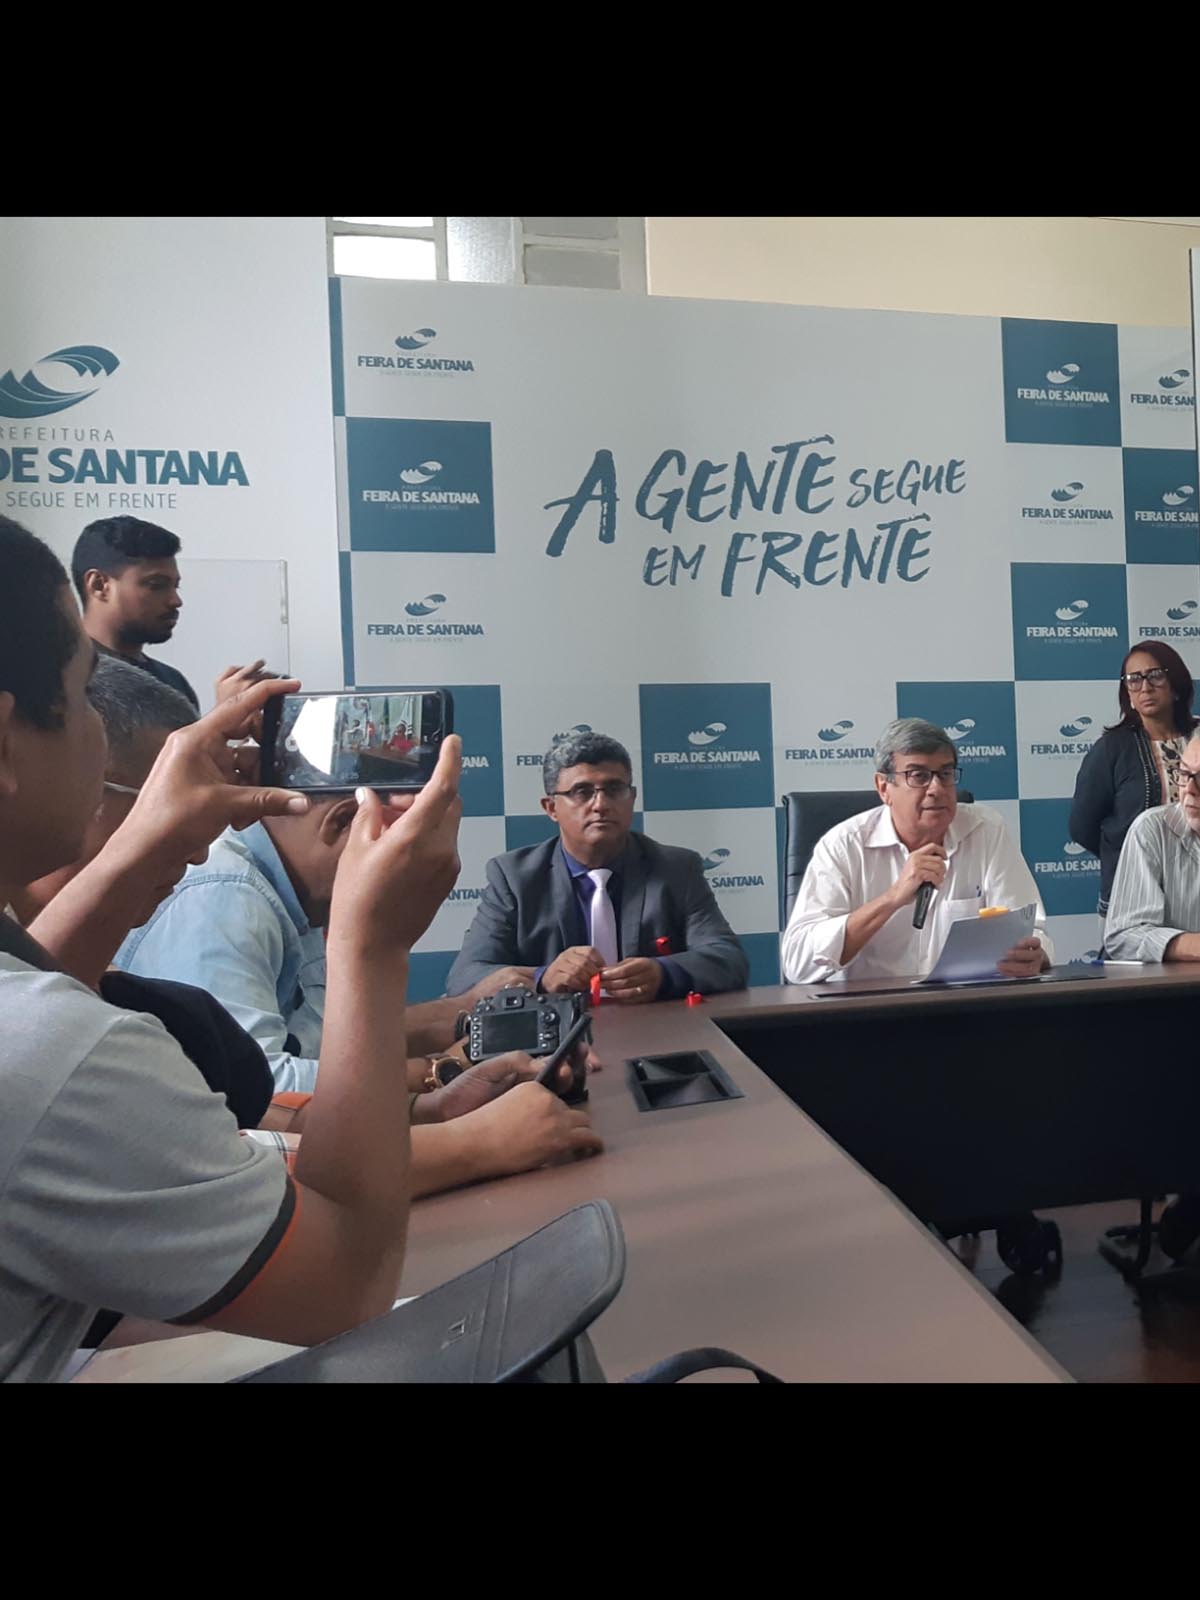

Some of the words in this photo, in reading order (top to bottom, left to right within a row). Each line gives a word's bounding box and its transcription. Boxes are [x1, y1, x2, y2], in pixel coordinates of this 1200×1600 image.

[358, 355, 395, 368] FEIRA
[397, 357, 414, 369] DE
[416, 358, 474, 372] SANTANA
[1017, 388, 1048, 400] FEIRA
[1049, 389, 1063, 401] DE
[1063, 390, 1109, 403] SANTANA
[1130, 393, 1158, 404] FEIRA
[1160, 395, 1173, 405] DE
[48, 447, 250, 487] SANTANA
[6, 491, 65, 508] SEGUE
[75, 492, 99, 508] EM
[109, 493, 176, 509] FRENTE
[362, 490, 400, 502] FEIRA
[402, 491, 420, 503] DE
[421, 491, 480, 504] SANTANA
[543, 449, 620, 558] A
[635, 433, 836, 533] GENTE
[846, 458, 966, 508] SEGUE
[1022, 507, 1050, 518] FEIRA
[1053, 508, 1067, 519] DE
[1068, 508, 1113, 520] SANTANA
[1135, 510, 1163, 521] FEIRA
[1164, 511, 1178, 522] DE
[643, 543, 706, 587] EM
[721, 513, 932, 597] FRENTE
[367, 624, 405, 635] FEIRA
[407, 624, 424, 635] DE
[426, 624, 484, 636] SANTANA
[1026, 627, 1057, 637] FEIRA
[1057, 627, 1072, 637] DE
[1072, 627, 1118, 637] SANTANA
[1139, 627, 1167, 637] FEIRA
[1168, 627, 1181, 637] DE
[785, 749, 818, 760] FEIRA
[820, 748, 835, 759] DE
[958, 745, 1006, 757] SANTANA
[1031, 744, 1060, 755] FEIRA
[1061, 744, 1075, 754] DE
[517, 755, 543, 766] FEIR
[654, 752, 689, 764] FEIRA
[690, 751, 706, 763] DE
[707, 750, 760, 762] SANTANA
[1035, 862, 1064, 873] FEIRA
[1065, 861, 1080, 871] DE
[712, 875, 764, 888] SANTANA
